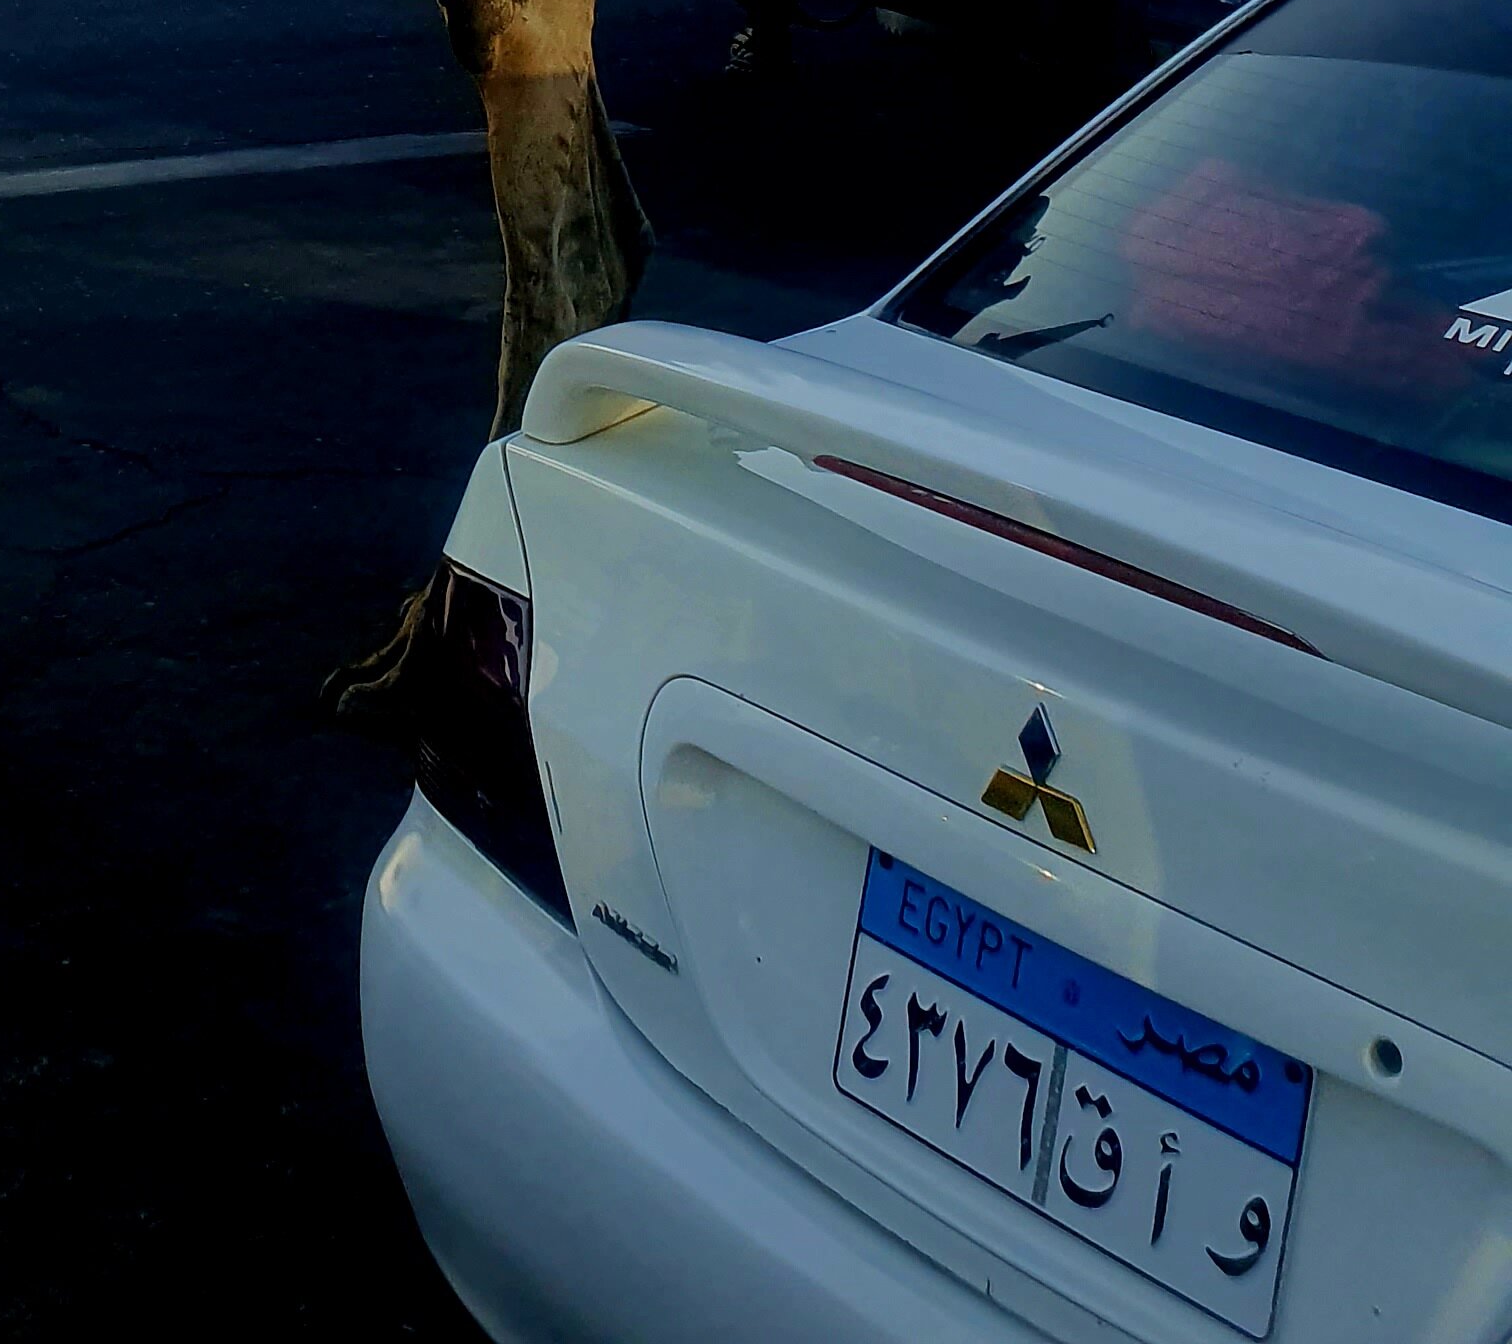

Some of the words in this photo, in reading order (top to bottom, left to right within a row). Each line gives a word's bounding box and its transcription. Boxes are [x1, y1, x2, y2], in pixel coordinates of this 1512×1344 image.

[898, 878, 1033, 989] EGYPT
[852, 972, 1042, 1171] ٤٣٧٦
[1116, 1016, 1261, 1092] مصر
